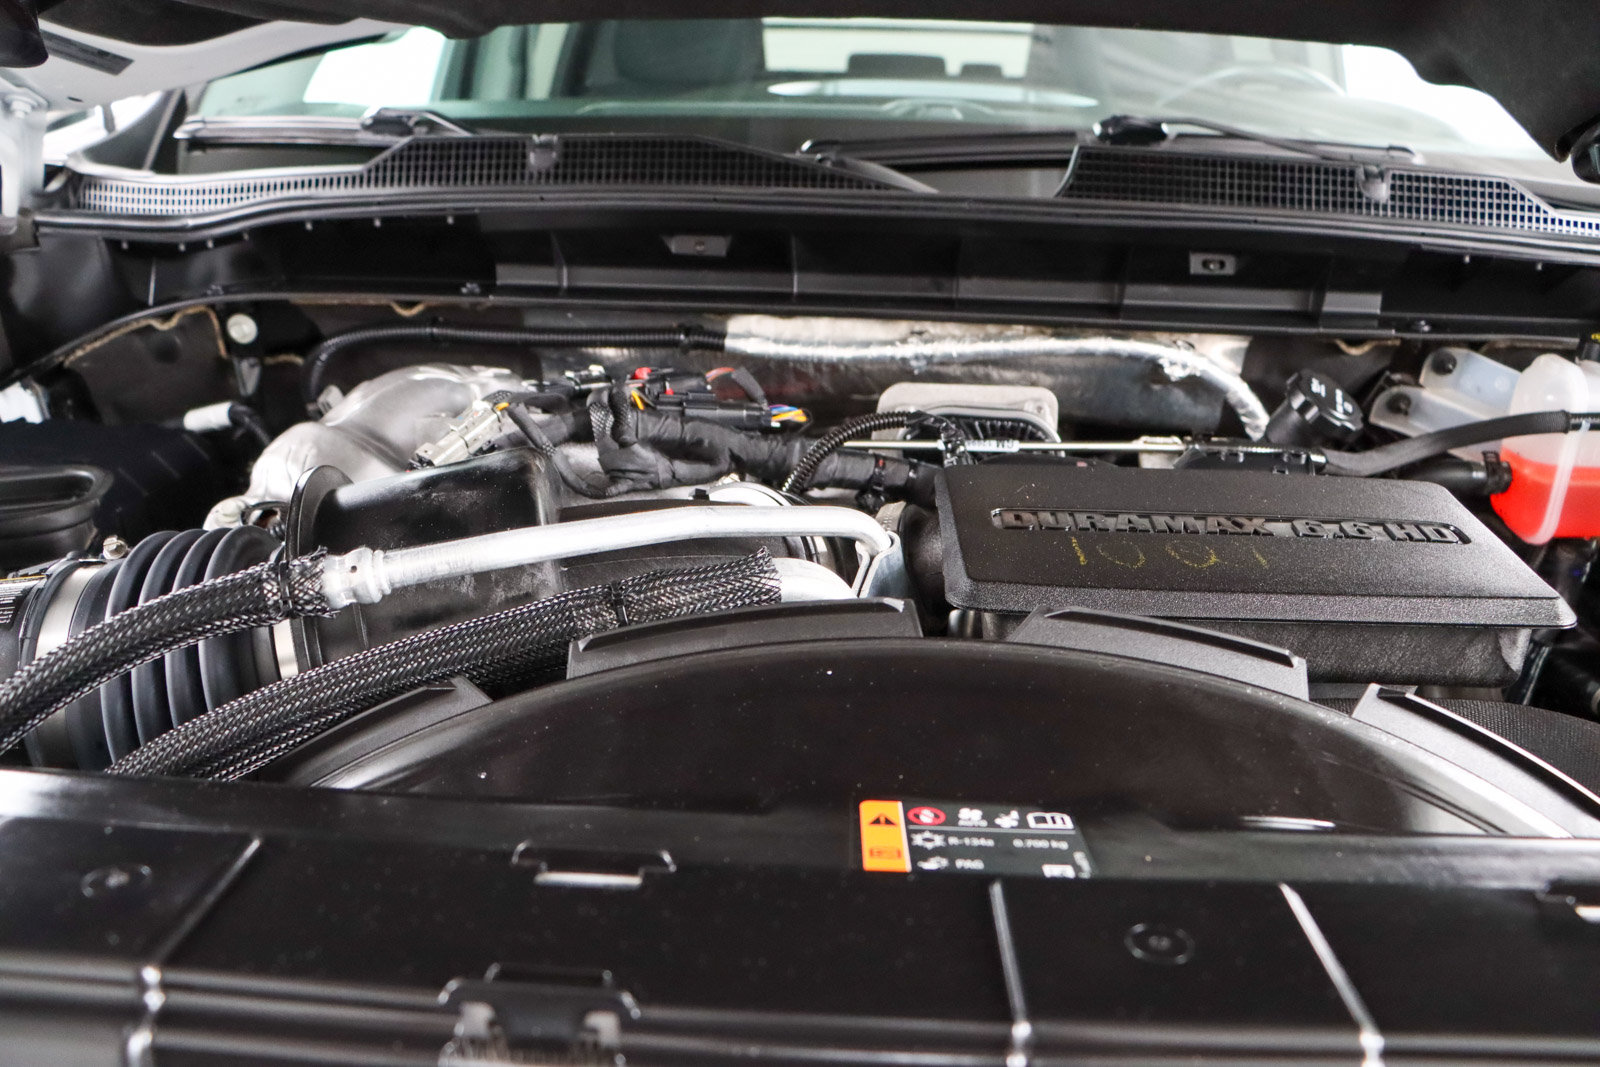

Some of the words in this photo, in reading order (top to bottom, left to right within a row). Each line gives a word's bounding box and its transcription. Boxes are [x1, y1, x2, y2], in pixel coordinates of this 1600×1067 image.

[1000, 510, 1275, 536] DURAMAX
[1291, 518, 1376, 541] 6.6
[1383, 520, 1460, 544] HD
